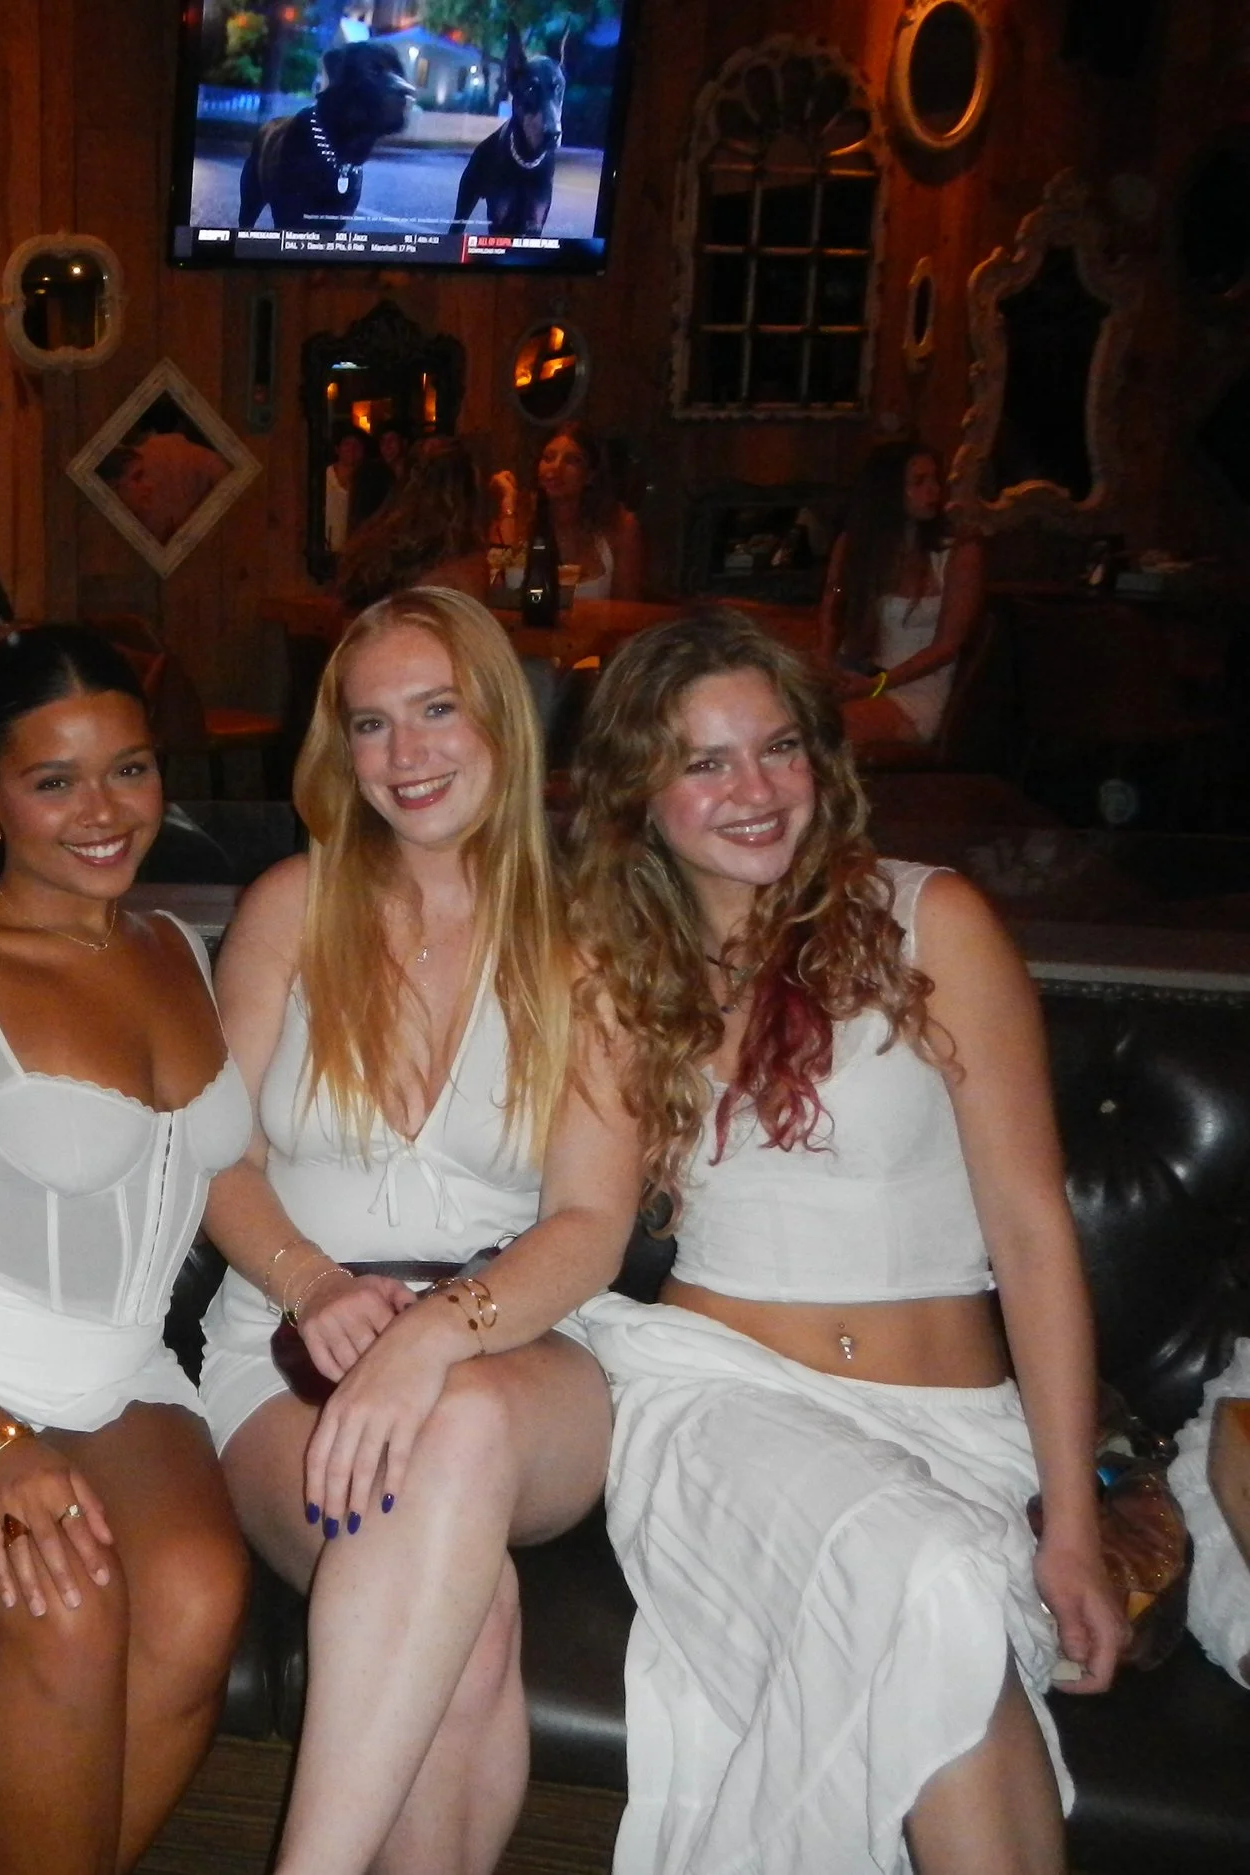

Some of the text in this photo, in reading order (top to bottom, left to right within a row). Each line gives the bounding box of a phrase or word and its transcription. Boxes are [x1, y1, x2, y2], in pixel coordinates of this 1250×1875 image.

[285, 231, 320, 241] Mavericks
[352, 233, 368, 242] Jazz
[284, 241, 298, 250] DAL
[398, 244, 406, 252] 17
[406, 244, 417, 253] Pts
